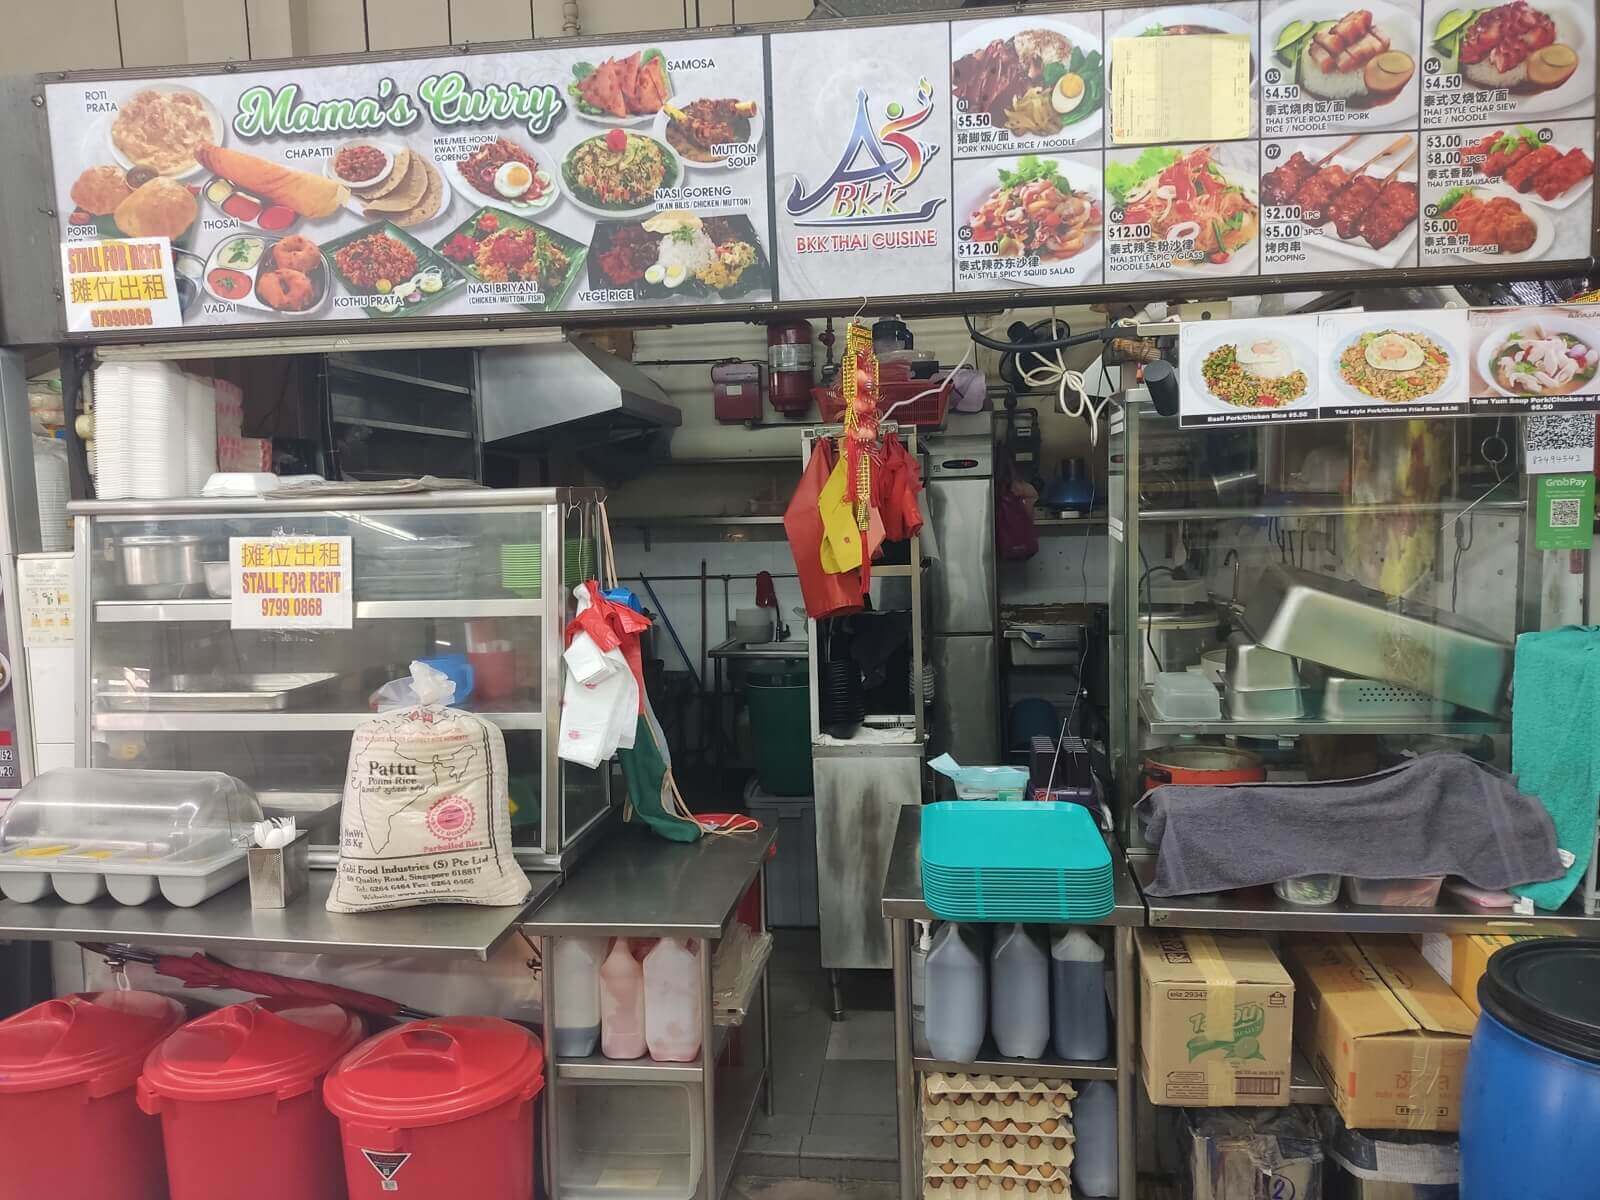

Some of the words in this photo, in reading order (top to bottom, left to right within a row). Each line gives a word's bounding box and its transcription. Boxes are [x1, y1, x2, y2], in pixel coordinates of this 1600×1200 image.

[667, 59, 715, 71] SAMOSA
[1268, 72, 1279, 81] 03
[1426, 75, 1461, 89] $4.50
[85, 90, 107, 101] ROTI
[1266, 87, 1299, 99] $4.50
[1424, 90, 1508, 107] 泰式叉烧饭/面
[86, 101, 118, 113] PRATA
[234, 78, 418, 136] Mama's
[419, 72, 563, 134] Curry
[1266, 101, 1345, 116] 泰式烧肉饭/面
[1424, 108, 1442, 116] THAI
[1445, 107, 1468, 115] STYLE
[1470, 105, 1494, 113] CHAR
[1496, 103, 1517, 111] SIEW
[959, 114, 990, 127] $5.50
[1266, 117, 1283, 125] THAI
[1286, 116, 1307, 124] STYLE
[1310, 114, 1346, 122] ROASTED
[1348, 112, 1370, 120] PORK
[1424, 116, 1442, 124] RICE
[1451, 114, 1488, 123] NOODLE
[1292, 124, 1327, 132] NOODLE
[434, 136, 467, 146] MEE/MEE
[470, 136, 497, 144] HOON/
[958, 145, 978, 153] PORK
[980, 143, 1015, 152] KNUCKLE
[1017, 141, 1035, 149] RICE
[1043, 138, 1076, 147] NOODLE
[1427, 136, 1461, 148] $3.00
[285, 147, 333, 159] CHAPATTI
[435, 146, 456, 154] KWAY
[712, 144, 757, 155] MUTTON
[1268, 148, 1279, 157] 07
[435, 153, 468, 162] GORENG
[728, 156, 757, 168] SOUP
[1428, 152, 1460, 165] $8.00
[1428, 167, 1473, 179] 泰式香肠
[1466, 178, 1500, 186] SAUSAGE
[656, 189, 680, 199] NASI
[684, 186, 732, 198] GORENG
[1112, 212, 1123, 221] 06
[1266, 207, 1300, 220] $2.00
[1304, 211, 1320, 220] 1PC
[1426, 207, 1438, 216] 09
[204, 220, 239, 230] THOSAI
[1425, 220, 1457, 233] $6.00
[68, 227, 96, 237] PORRI
[960, 230, 972, 238] 05
[1109, 226, 1150, 238] $12.00
[1266, 225, 1300, 238] $5.00
[1304, 228, 1324, 236] 3PCS
[797, 236, 829, 254] BKK
[831, 234, 868, 251] THAI
[872, 230, 938, 248] CUISINE
[1424, 235, 1469, 247] 泰式鱼饼
[960, 243, 999, 256] $12.00
[1110, 240, 1193, 255] 泰式辣冬粉沙律
[1266, 242, 1301, 254] 烤肉串
[1463, 245, 1497, 253] FISHCAKE
[68, 247, 101, 273] STALL
[104, 246, 128, 271] FOR
[130, 244, 162, 270] RENT
[1110, 256, 1128, 264] THAI
[1130, 254, 1150, 262] STYLE
[1153, 253, 1176, 261] SPICY
[1177, 251, 1204, 260] GLASS
[1266, 254, 1306, 262] MOOPING
[1110, 264, 1144, 272] NOODLE
[1146, 262, 1172, 270] SALAD
[960, 273, 976, 281] THAI
[978, 271, 998, 279] STYLE
[1000, 270, 1022, 278] SPICY
[1024, 269, 1048, 277] SQUID
[1050, 267, 1075, 275] SALAD
[70, 275, 168, 303] 摊位出租
[469, 284, 492, 294] NASI
[496, 282, 537, 292] BRIYANI
[334, 296, 368, 308] KOTHU
[370, 296, 404, 307] PRATA
[578, 292, 607, 302] VEGE
[610, 290, 633, 301] RICE
[204, 304, 236, 314] VADAI
[1508, 398, 1529, 406] Soup
[1546, 478, 1587, 488] GrabPay
[242, 543, 341, 568] 摊位出租
[242, 572, 278, 594] STALL
[283, 572, 306, 594] FOR
[310, 572, 341, 594] RENT
[262, 598, 290, 617] 9799
[294, 598, 323, 617] 0868
[368, 760, 417, 776] Pattu
[368, 777, 393, 786] Ponni
[345, 839, 352, 847] 25
[353, 839, 363, 849] Kg
[424, 842, 464, 853] Parboiled
[357, 865, 378, 875] Food
[381, 862, 430, 874] Industries
[433, 860, 449, 870] (S)
[452, 858, 469, 867] Pte
[472, 855, 489, 865] Ltd
[355, 874, 382, 885] Quality
[384, 873, 408, 883] Road,
[409, 872, 450, 883] Singapore
